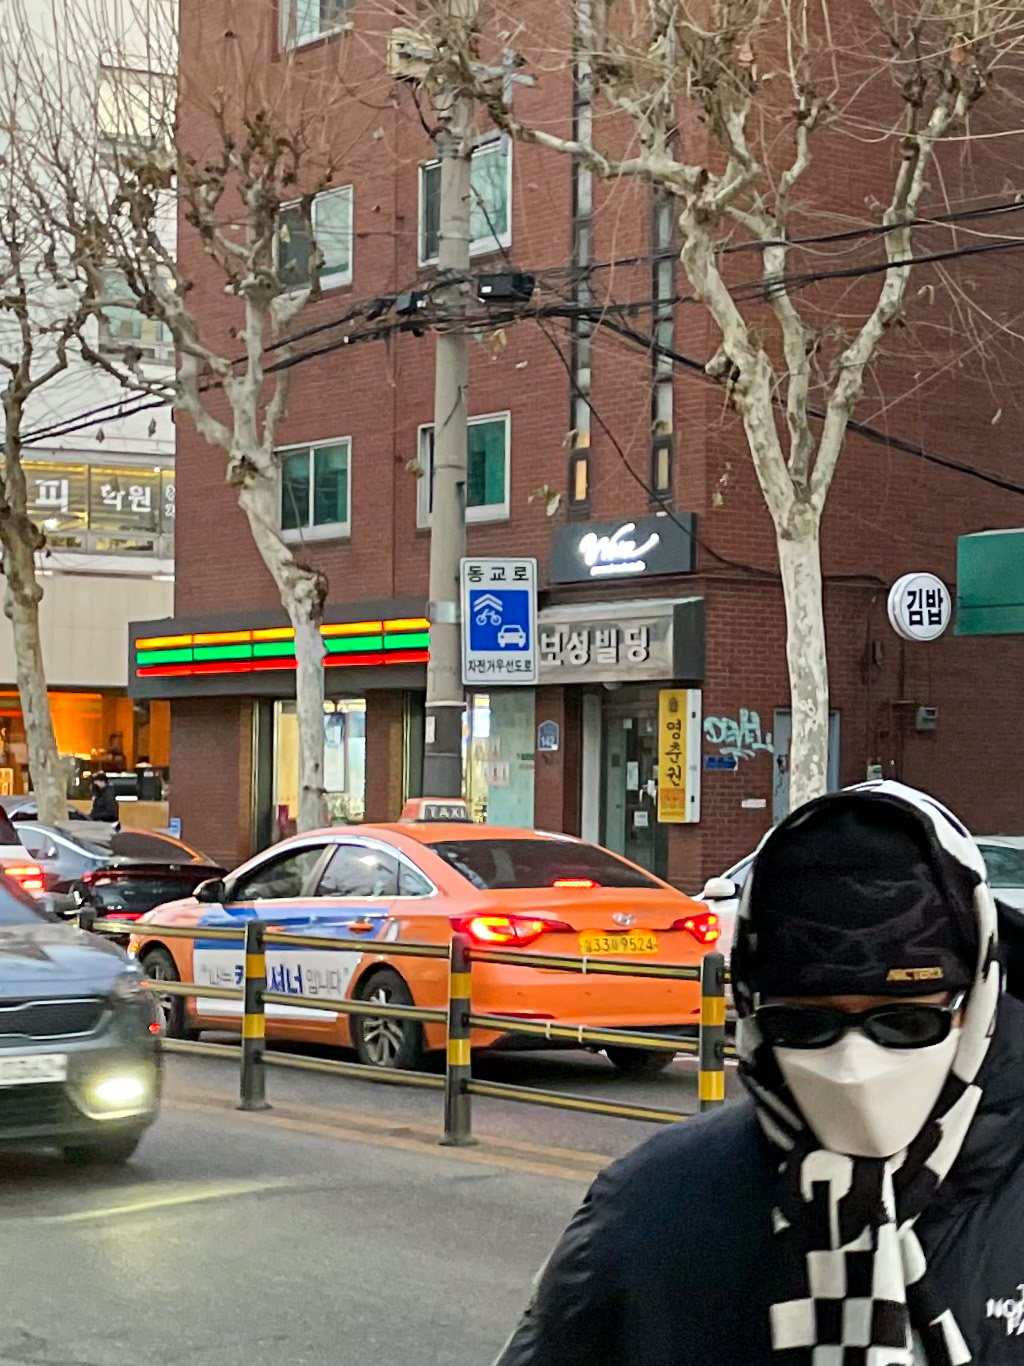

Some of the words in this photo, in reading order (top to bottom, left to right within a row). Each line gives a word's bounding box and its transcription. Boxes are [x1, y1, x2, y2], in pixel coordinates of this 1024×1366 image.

[467, 565, 530, 583] 동교로
[906, 588, 944, 627] 김밥
[540, 625, 651, 666] 보성빌딩
[468, 658, 533, 674] 자전거우선도로
[428, 805, 466, 819] TAXI
